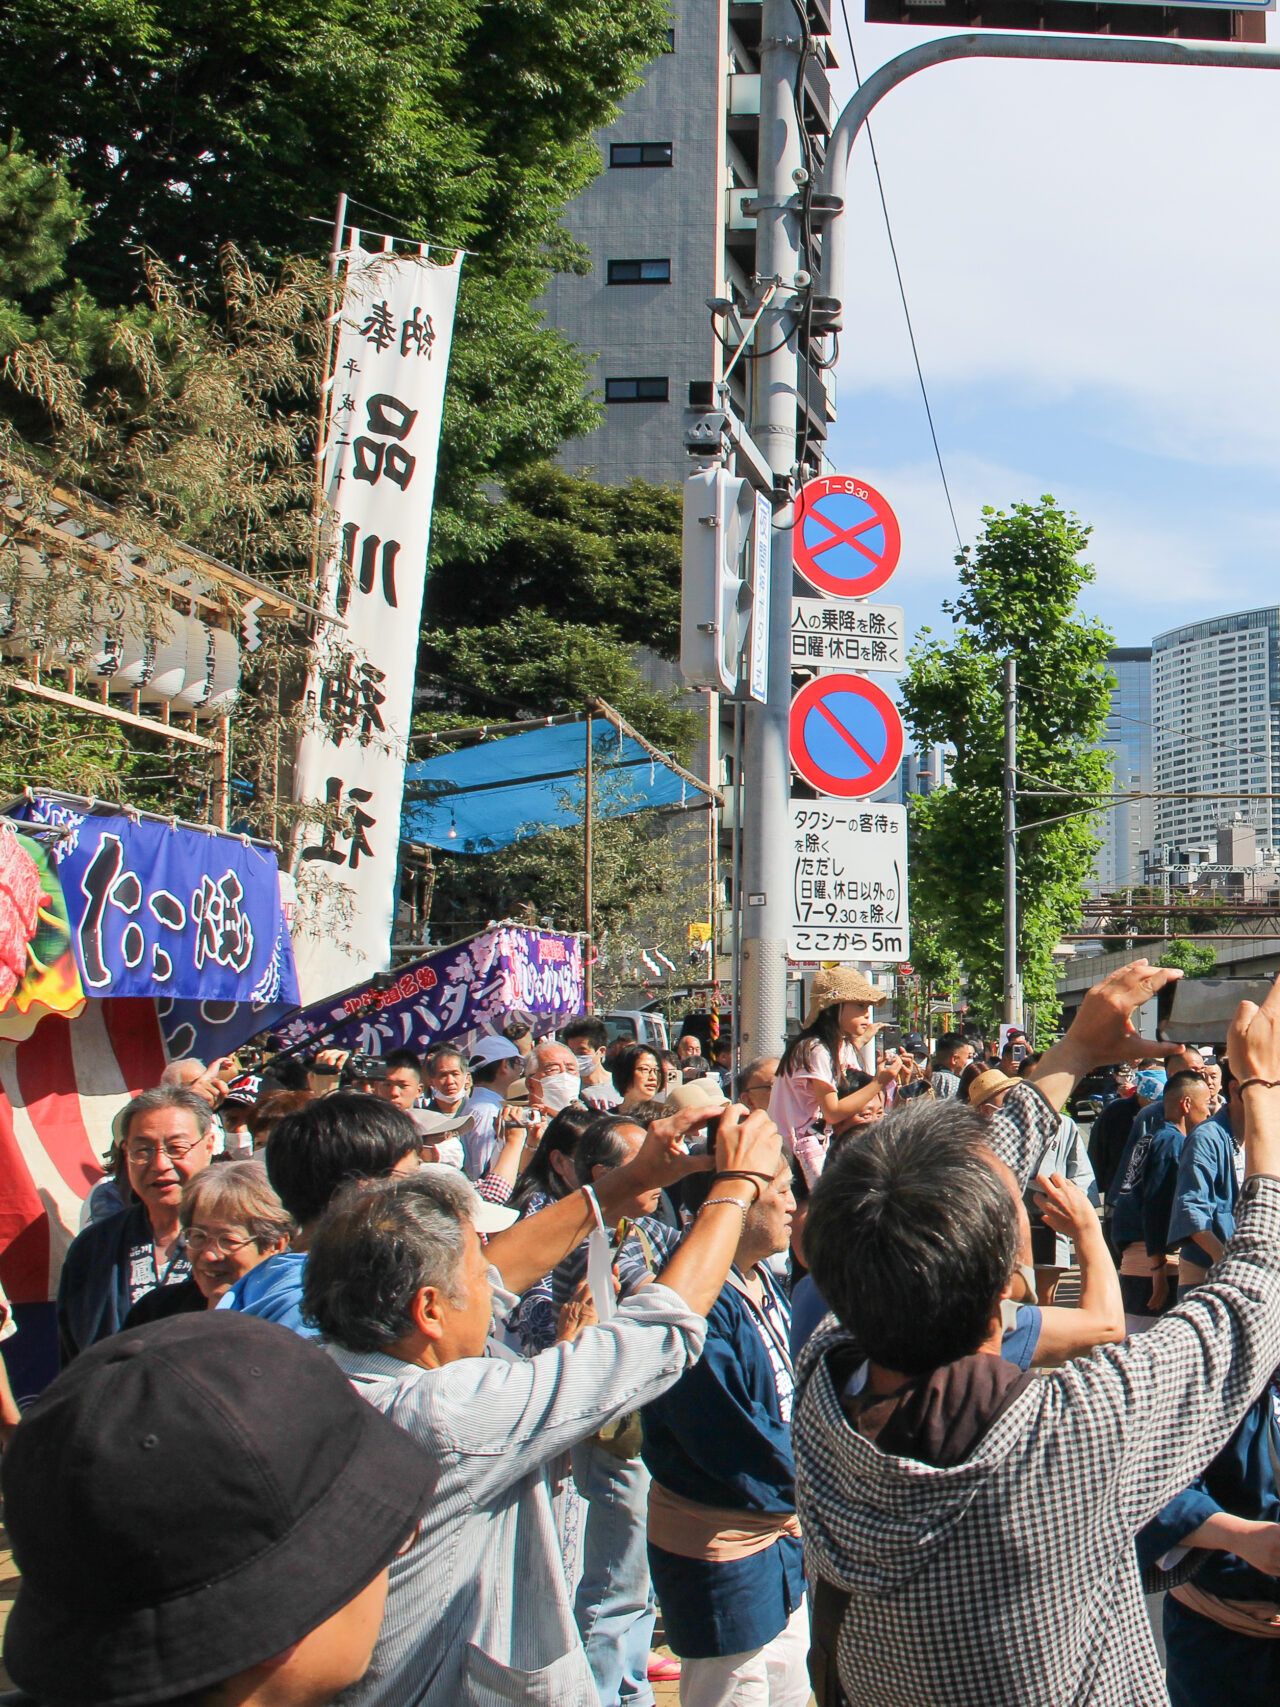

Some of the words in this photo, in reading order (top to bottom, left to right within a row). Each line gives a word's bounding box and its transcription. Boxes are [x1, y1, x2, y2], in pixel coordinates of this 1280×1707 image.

[791, 607, 898, 635] 人の乗降を除く
[794, 810, 899, 833] タクシーの客待ち
[794, 833, 830, 853] を除く
[801, 880, 895, 901] 日曜、休日以外の
